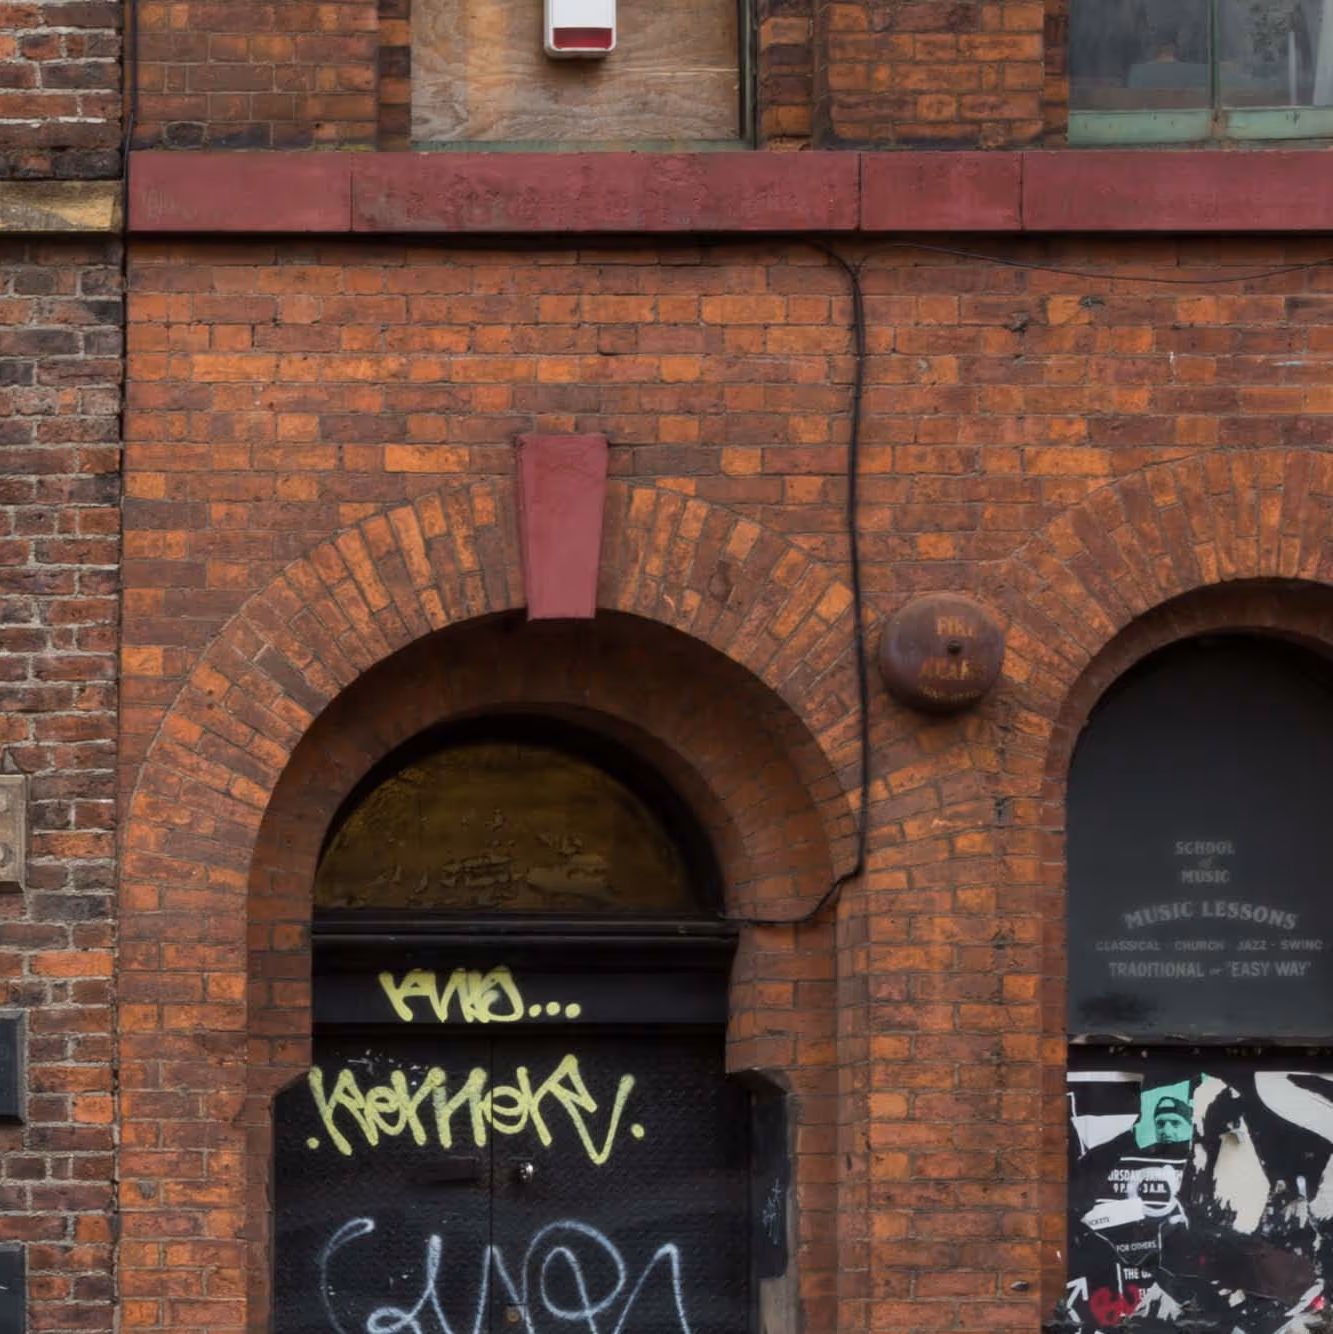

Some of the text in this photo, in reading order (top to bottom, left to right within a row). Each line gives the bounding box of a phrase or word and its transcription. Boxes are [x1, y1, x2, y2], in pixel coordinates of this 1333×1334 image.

[1174, 840, 1236, 856] SCHOOL
[1181, 869, 1230, 884] MUSIC
[1123, 900, 1298, 930] MUSIC LESSONS
[1109, 961, 1205, 978] TRADITIONAL
